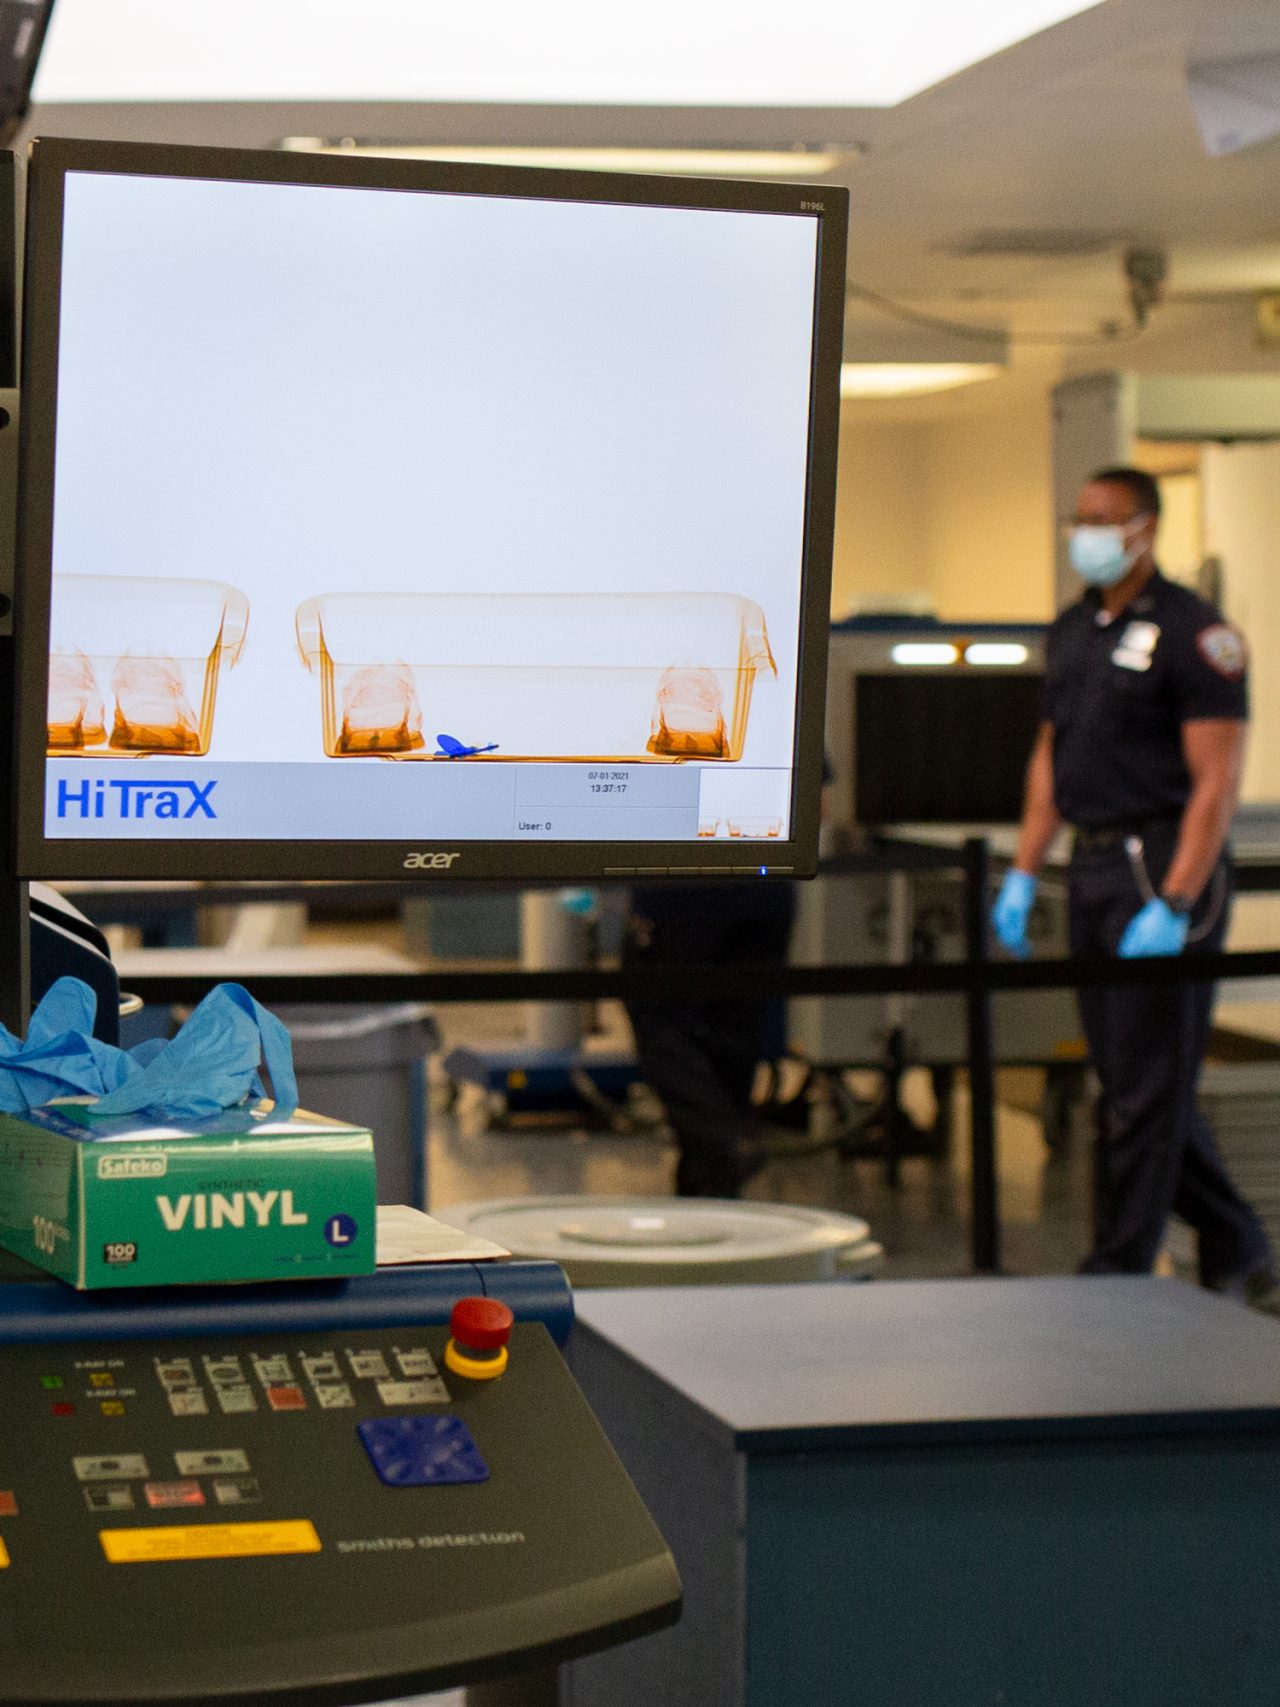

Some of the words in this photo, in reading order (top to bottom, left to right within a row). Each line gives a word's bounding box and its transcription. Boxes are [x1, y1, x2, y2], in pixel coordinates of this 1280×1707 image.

[800, 201, 825, 211] B196L
[588, 771, 629, 780] 07-01-2021
[591, 784, 627, 793] 13:37:17
[57, 779, 218, 819] HiTraX
[518, 822, 543, 831] User:
[545, 821, 552, 831] 0
[403, 853, 460, 869] acer
[102, 1158, 163, 1175] Safeko
[156, 1190, 308, 1231] VINYL
[332, 1219, 349, 1243] L
[106, 1243, 136, 1258] 100
[337, 1538, 415, 1552] smiths
[418, 1532, 525, 1548] detection
